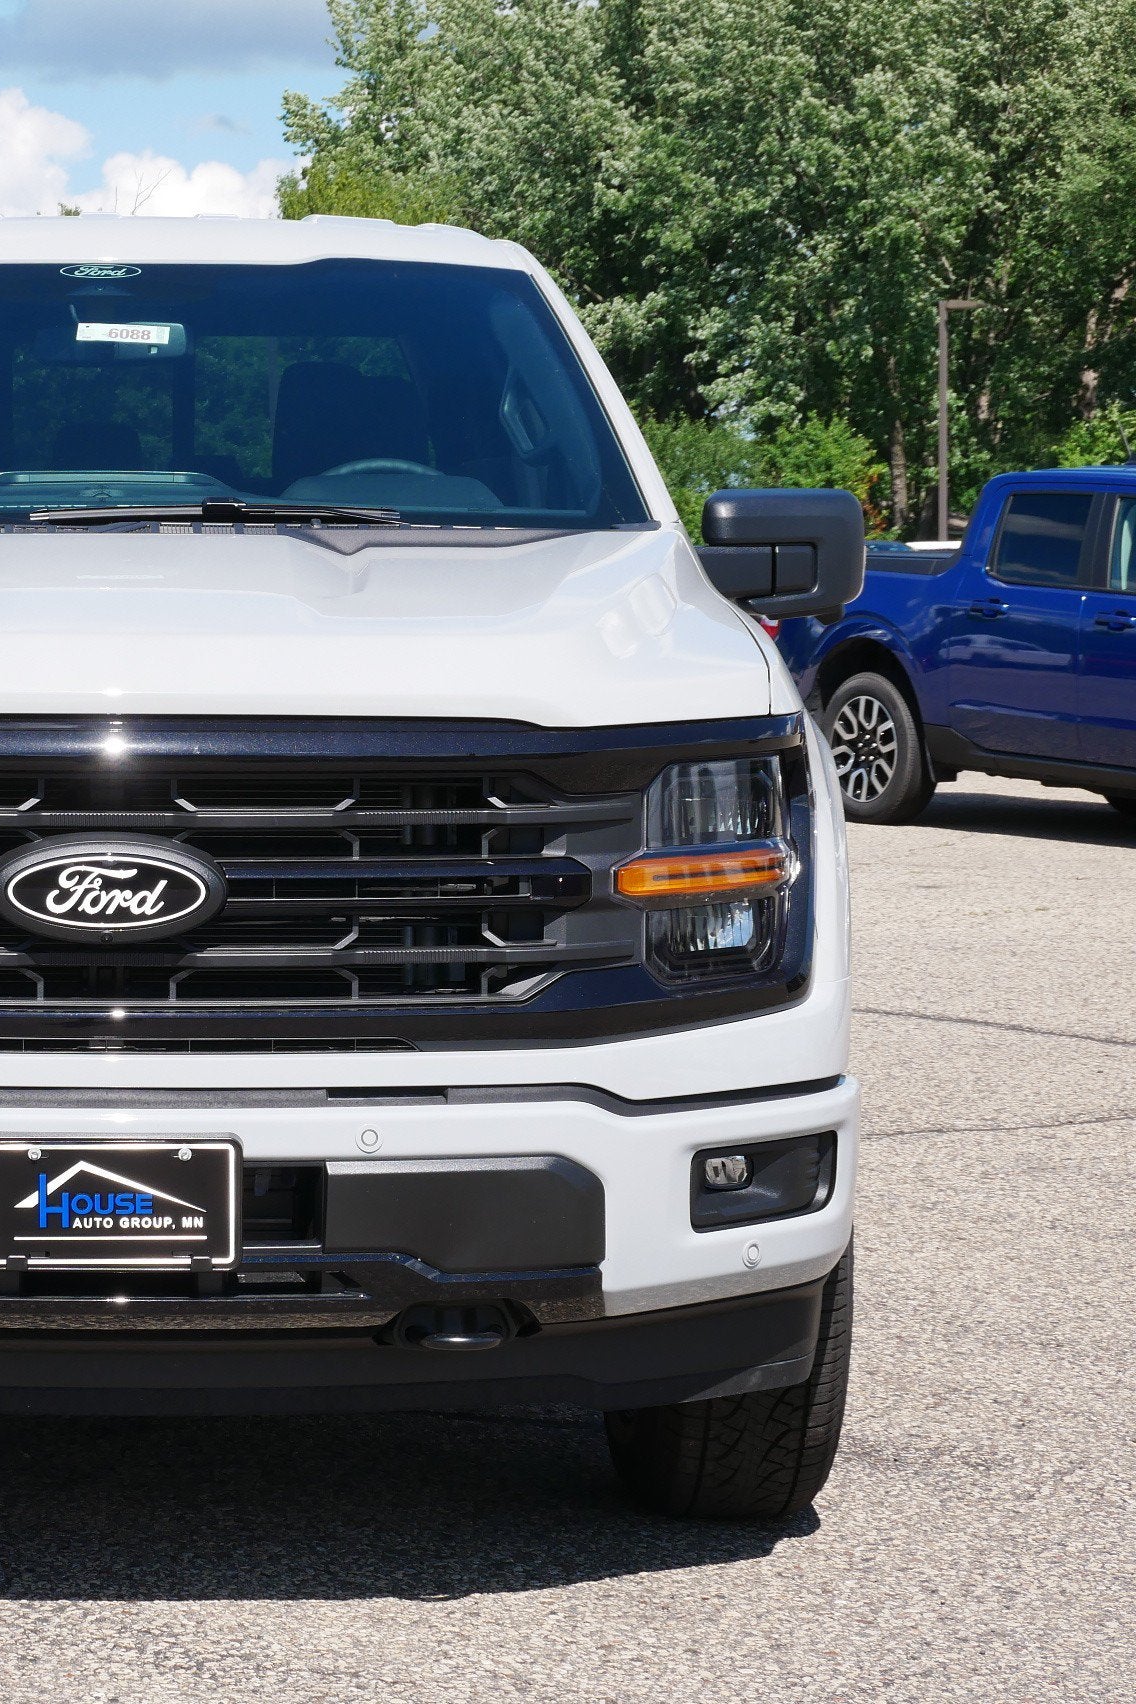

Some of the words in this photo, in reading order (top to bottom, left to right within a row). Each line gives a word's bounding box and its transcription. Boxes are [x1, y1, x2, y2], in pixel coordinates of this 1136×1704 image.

[74, 265, 127, 276] Ford
[108, 328, 151, 341] 6088
[45, 865, 168, 916] Ford
[38, 1172, 153, 1229] HOUSE
[72, 1217, 114, 1229] AUTO
[119, 1216, 176, 1230] GROUP,
[181, 1216, 204, 1228] MN
